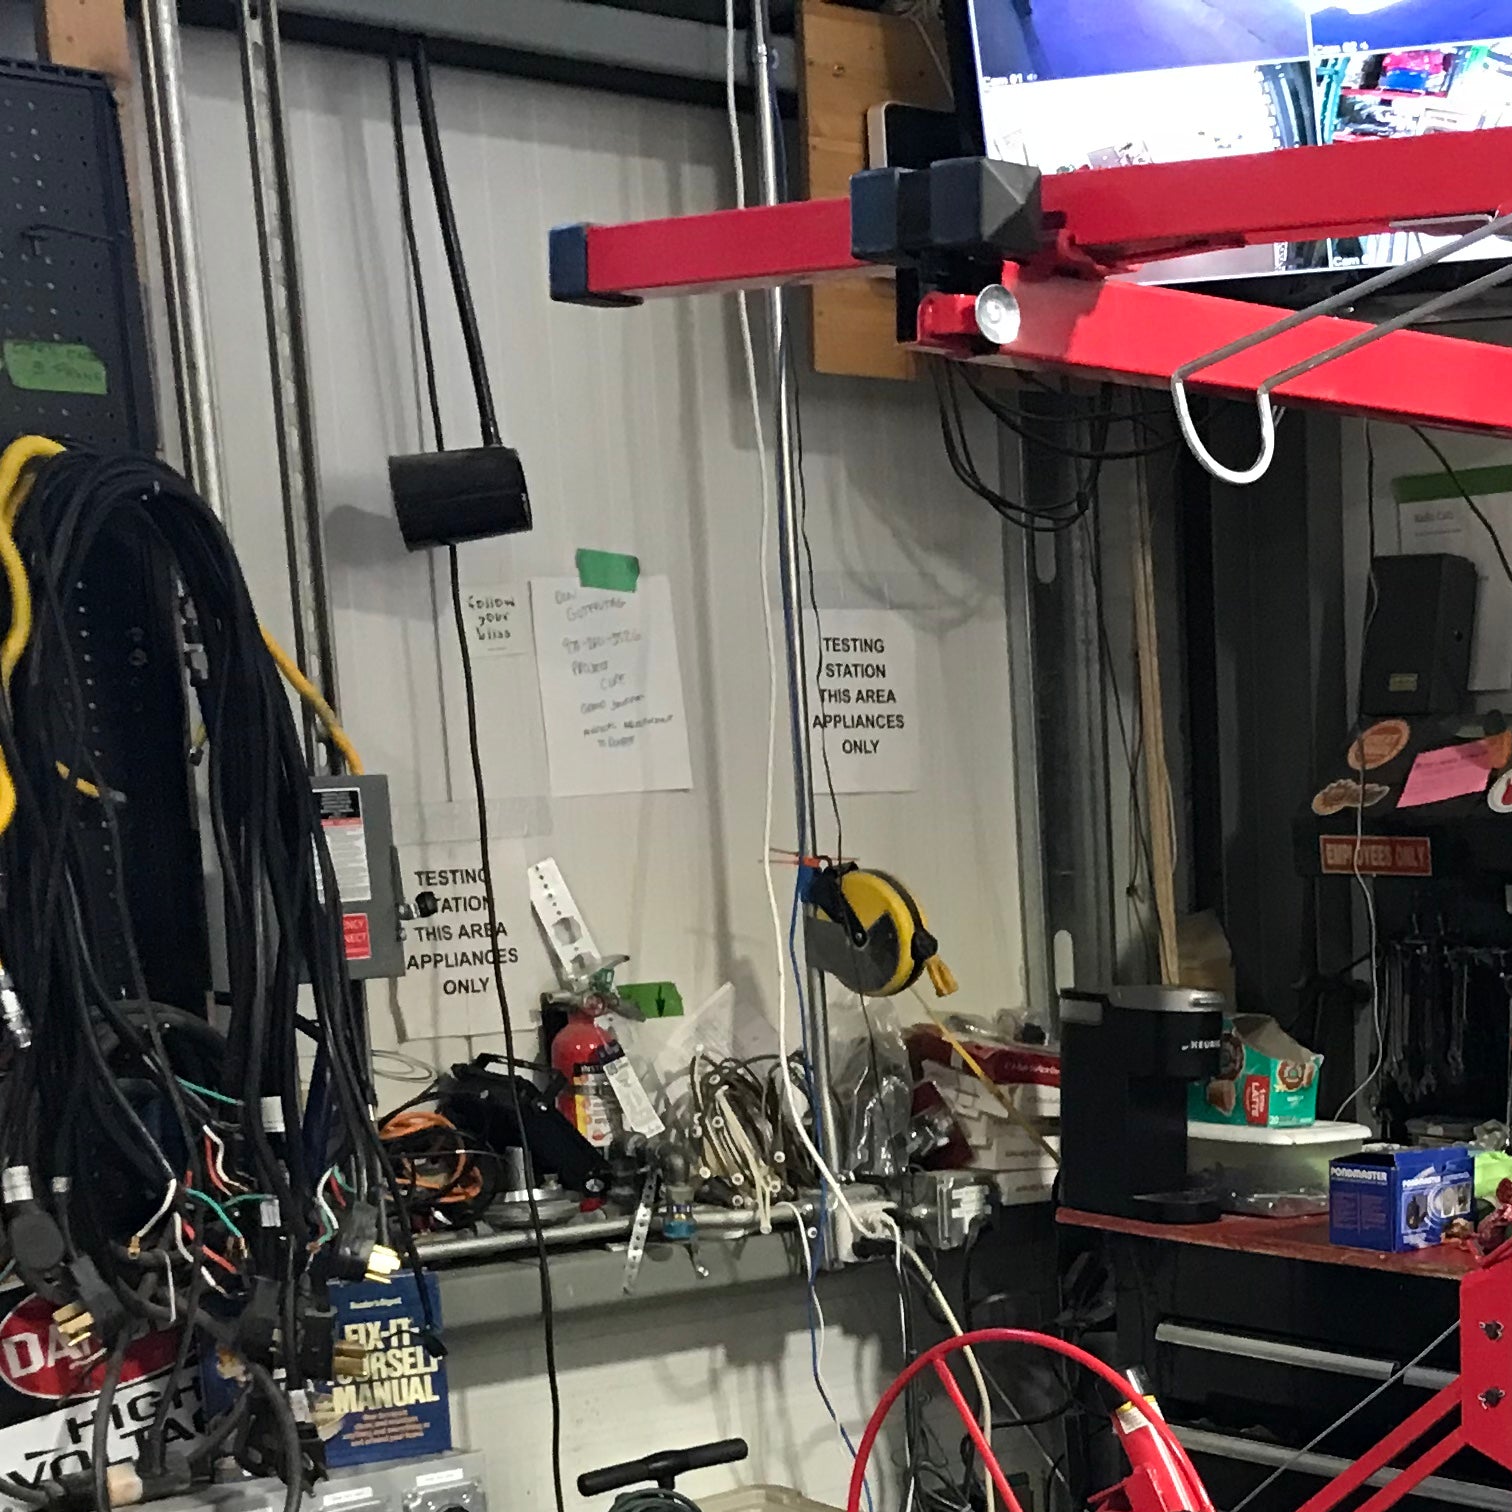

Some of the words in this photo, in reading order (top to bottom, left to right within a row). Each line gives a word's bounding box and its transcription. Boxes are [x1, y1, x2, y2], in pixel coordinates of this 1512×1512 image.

[822, 637, 885, 654] TESTING
[825, 663, 887, 679] STATION
[820, 688, 852, 704] THIS
[855, 688, 897, 704] AREA
[812, 713, 905, 729] APPLIANCES
[841, 738, 880, 754] ONLY
[1326, 843, 1392, 867] EMPOYEES
[414, 925, 453, 942] THIS
[459, 921, 508, 939] AREA
[406, 948, 519, 970] APPLIANCES
[443, 977, 490, 996] ONLY
[1190, 1039, 1221, 1050] KEURI
[332, 1374, 440, 1414] MANUAL
